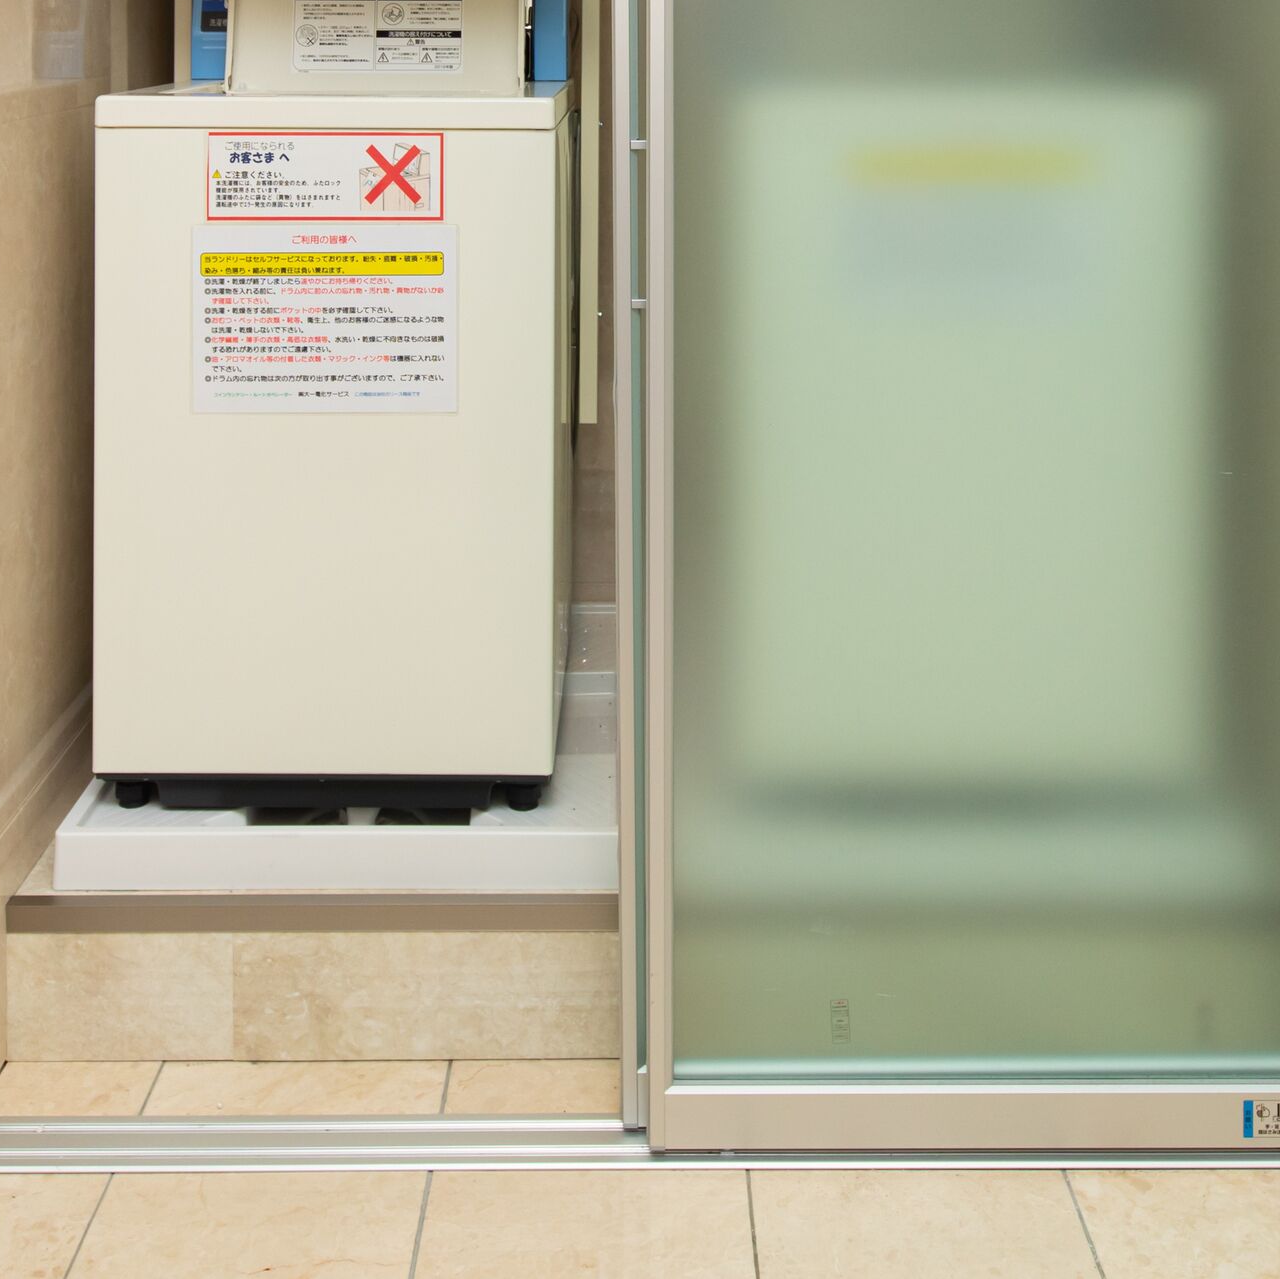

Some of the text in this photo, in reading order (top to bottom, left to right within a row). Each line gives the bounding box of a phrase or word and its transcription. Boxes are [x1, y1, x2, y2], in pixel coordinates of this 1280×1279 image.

[224, 141, 295, 151] ご使用になられる
[291, 235, 357, 244] ご利用の皆様へ
